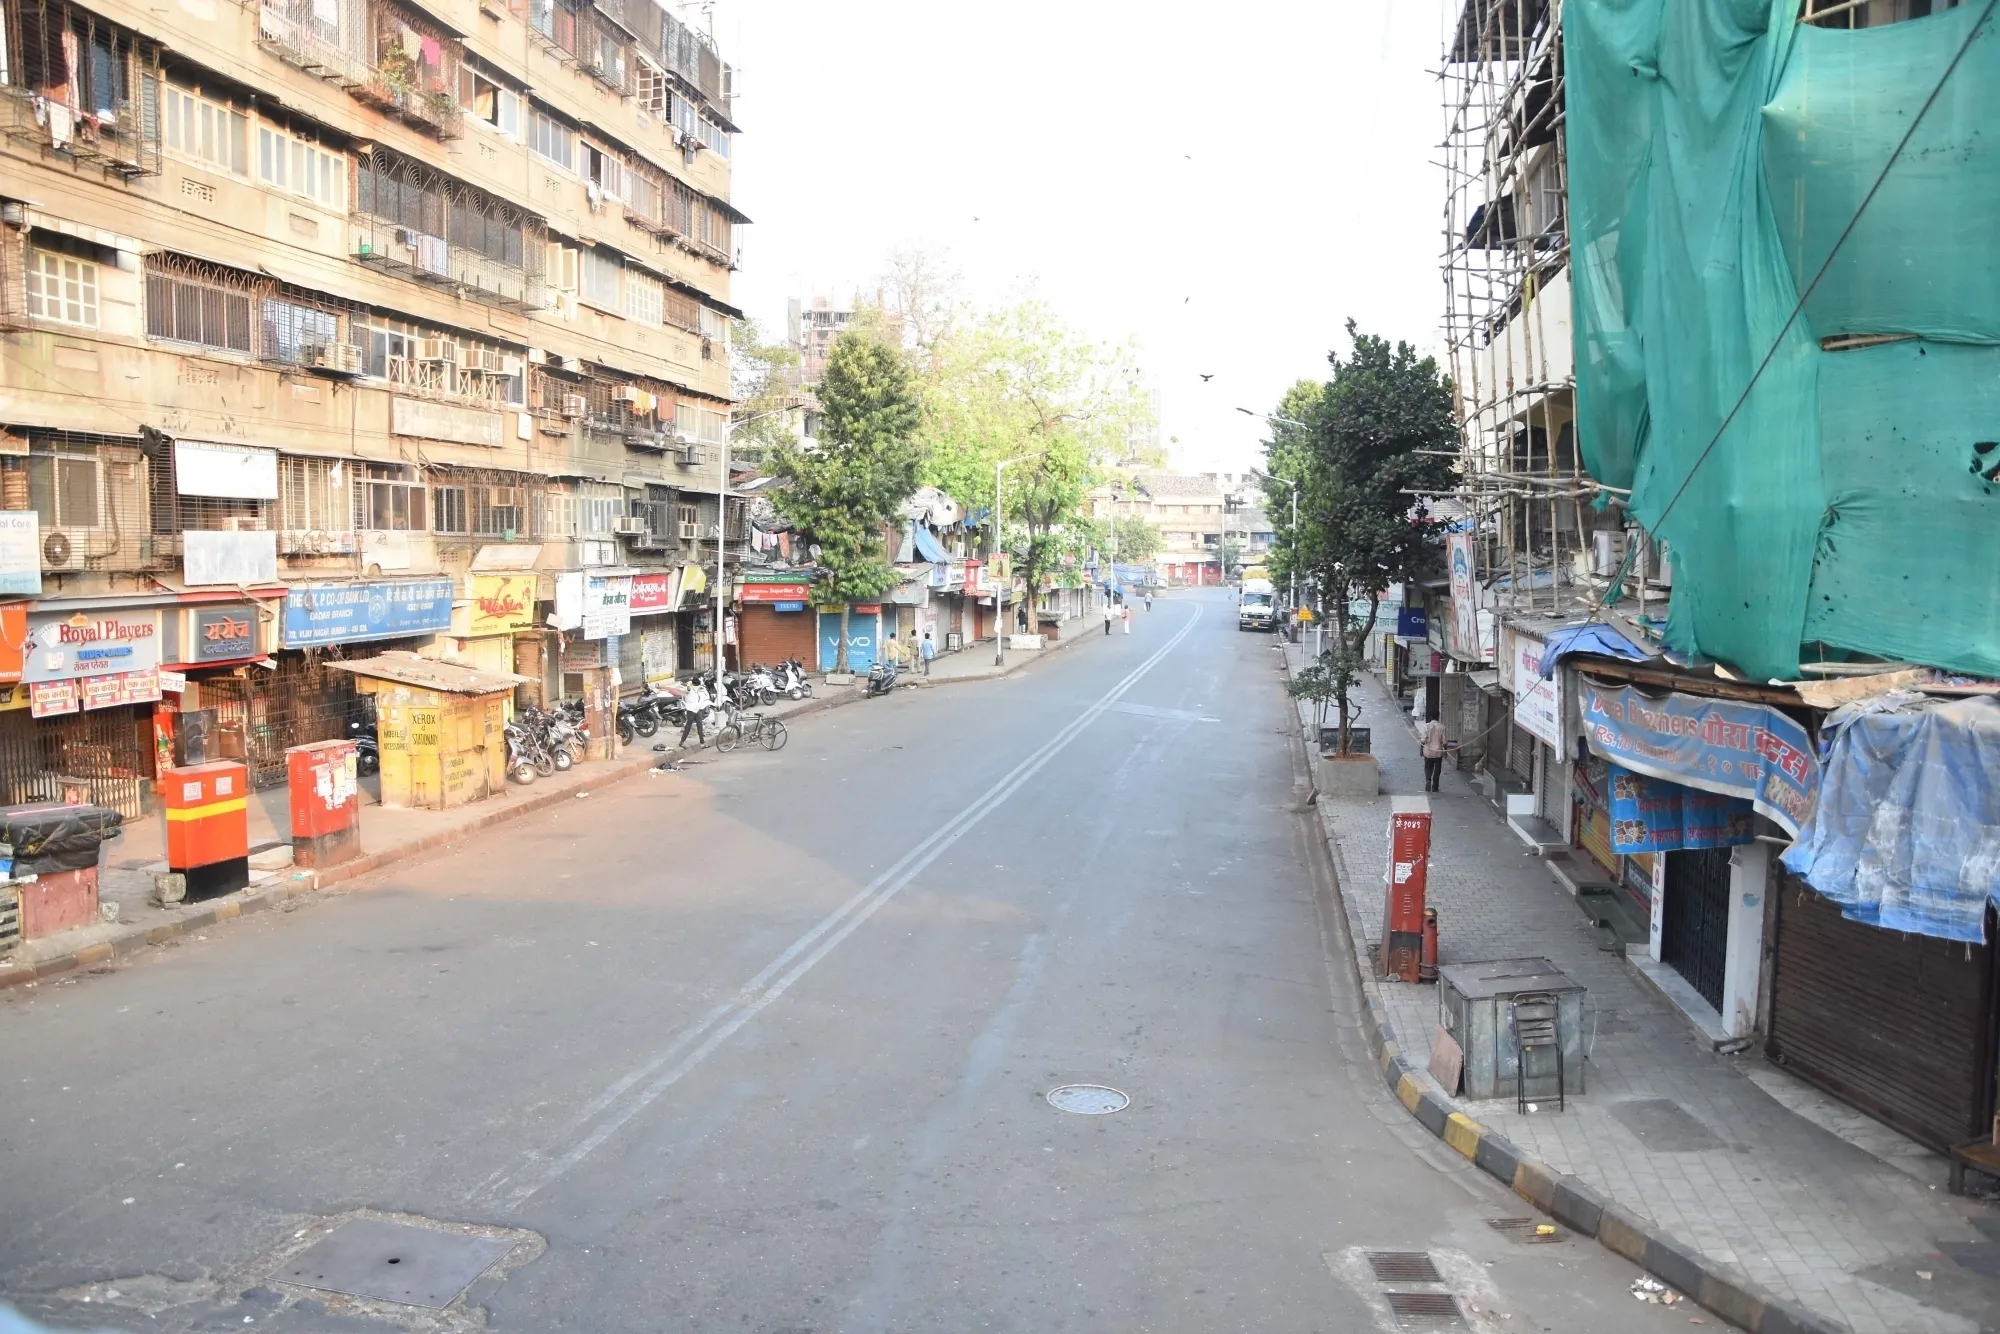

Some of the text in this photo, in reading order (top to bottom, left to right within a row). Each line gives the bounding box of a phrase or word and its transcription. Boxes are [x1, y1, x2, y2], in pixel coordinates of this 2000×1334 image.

[177, 440, 199, 449] EVER
[200, 442, 221, 451] SMILE
[12, 519, 32, 528] Care
[289, 593, 303, 609] THE
[345, 590, 360, 604] BANK
[310, 609, 354, 621] DADAR BRANCH
[1411, 616, 1425, 624] Cro
[59, 619, 154, 646] Royal Players
[203, 616, 250, 641] सरोज
[77, 648, 105, 660] VIDEO
[74, 660, 90, 672] रॉयल
[412, 713, 436, 725] XEROX
[1628, 699, 1698, 737] Brothers
[383, 730, 404, 739] MOBILE
